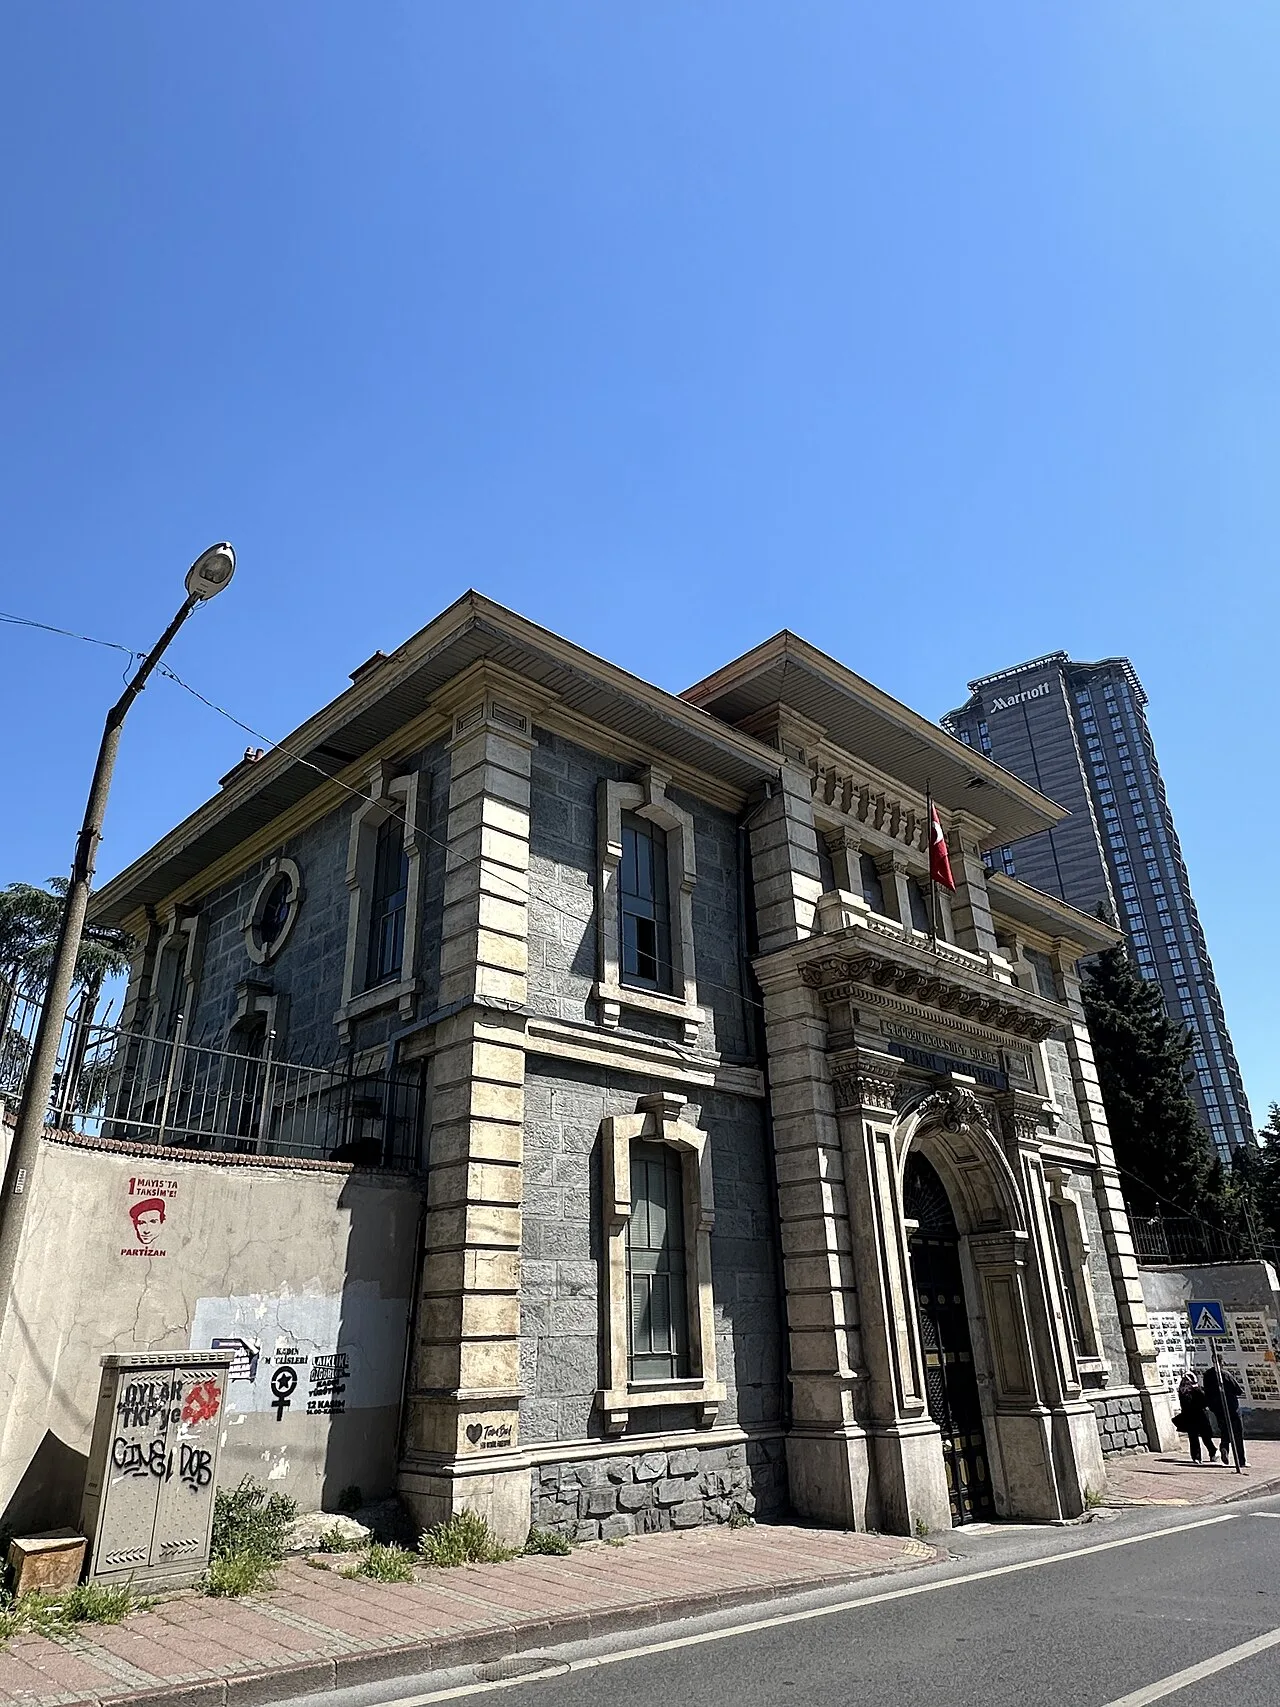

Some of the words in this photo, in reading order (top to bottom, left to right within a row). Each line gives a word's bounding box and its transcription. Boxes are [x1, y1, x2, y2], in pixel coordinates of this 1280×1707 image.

[990, 682, 1050, 714] Marriott
[128, 1177, 136, 1195] 1
[120, 1246, 167, 1257] PARTİZAN
